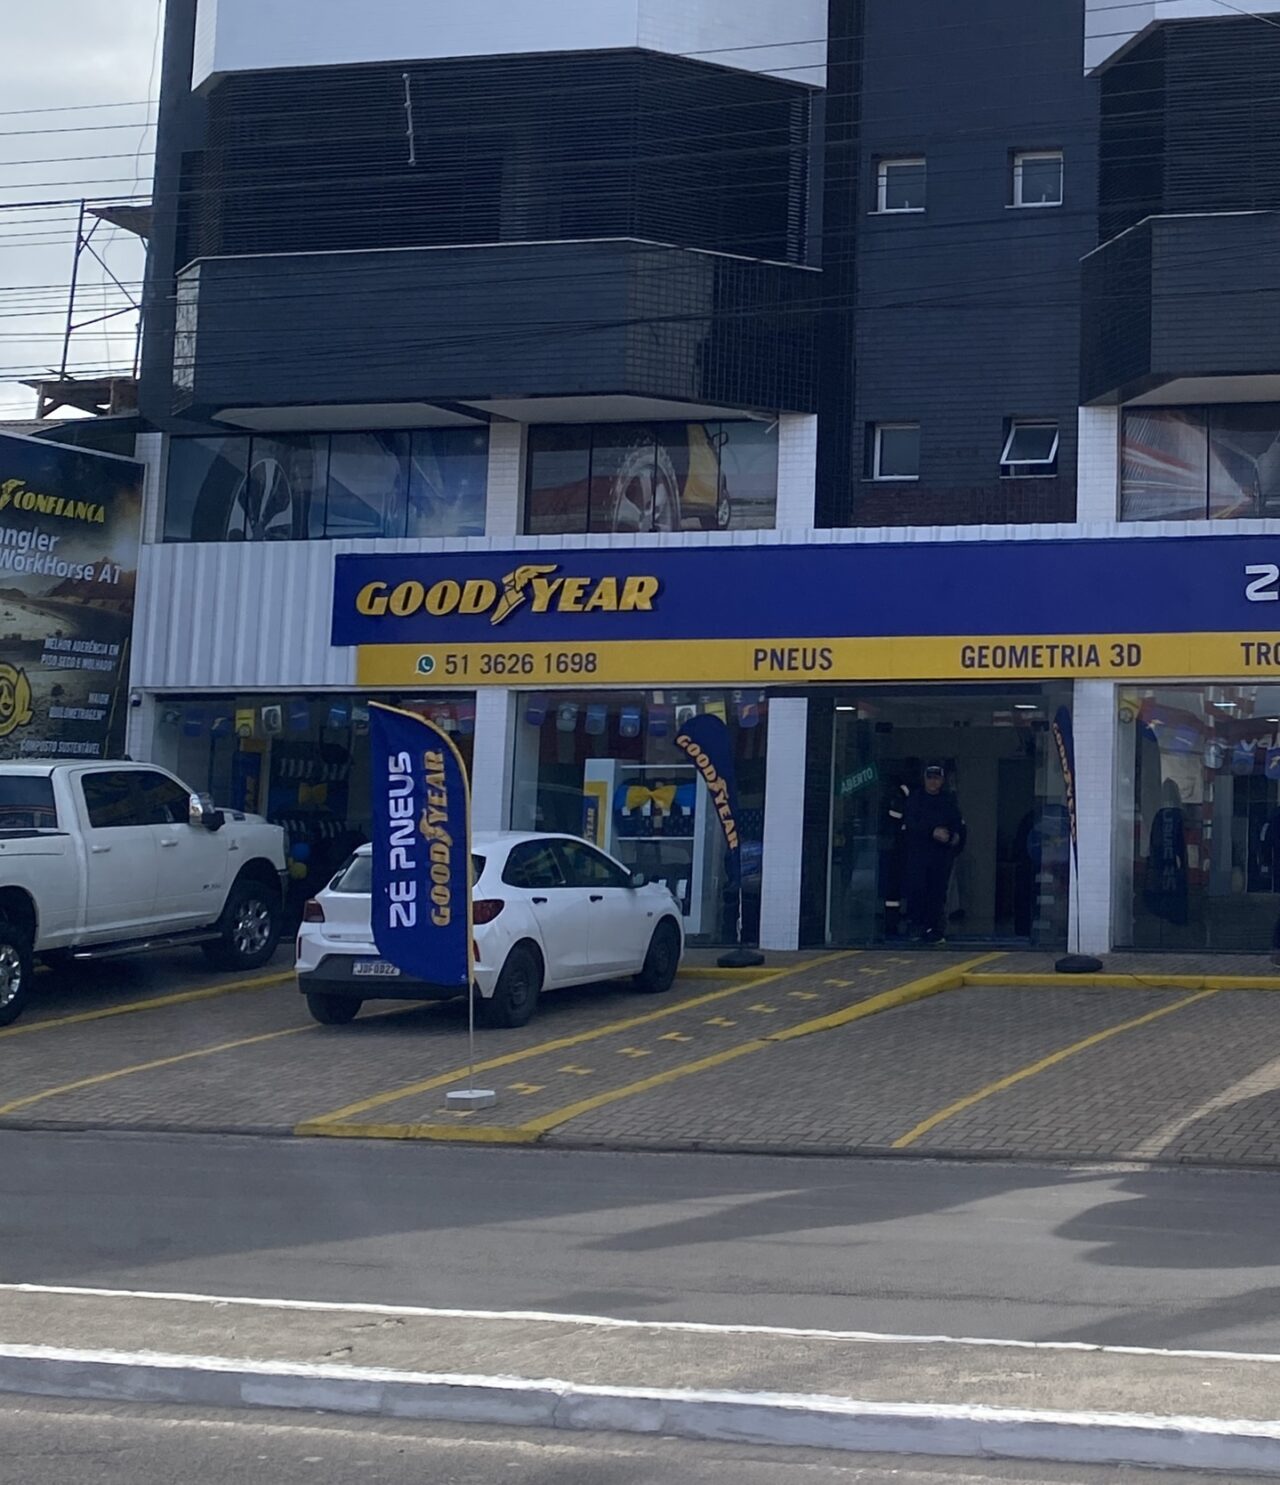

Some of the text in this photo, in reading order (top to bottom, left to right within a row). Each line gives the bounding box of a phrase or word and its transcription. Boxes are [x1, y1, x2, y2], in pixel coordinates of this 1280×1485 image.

[13, 490, 105, 523] CONFIANÇA
[356, 570, 660, 620] GOODYEAR
[445, 652, 598, 674] 51 3626 1698
[753, 647, 833, 671] PNEUS
[961, 643, 1142, 669] GEOMETRIA 3D
[676, 735, 739, 850] GOODYEAR
[385, 751, 417, 928] ZÉ PNEUS
[423, 750, 452, 927] GOODYEAR
